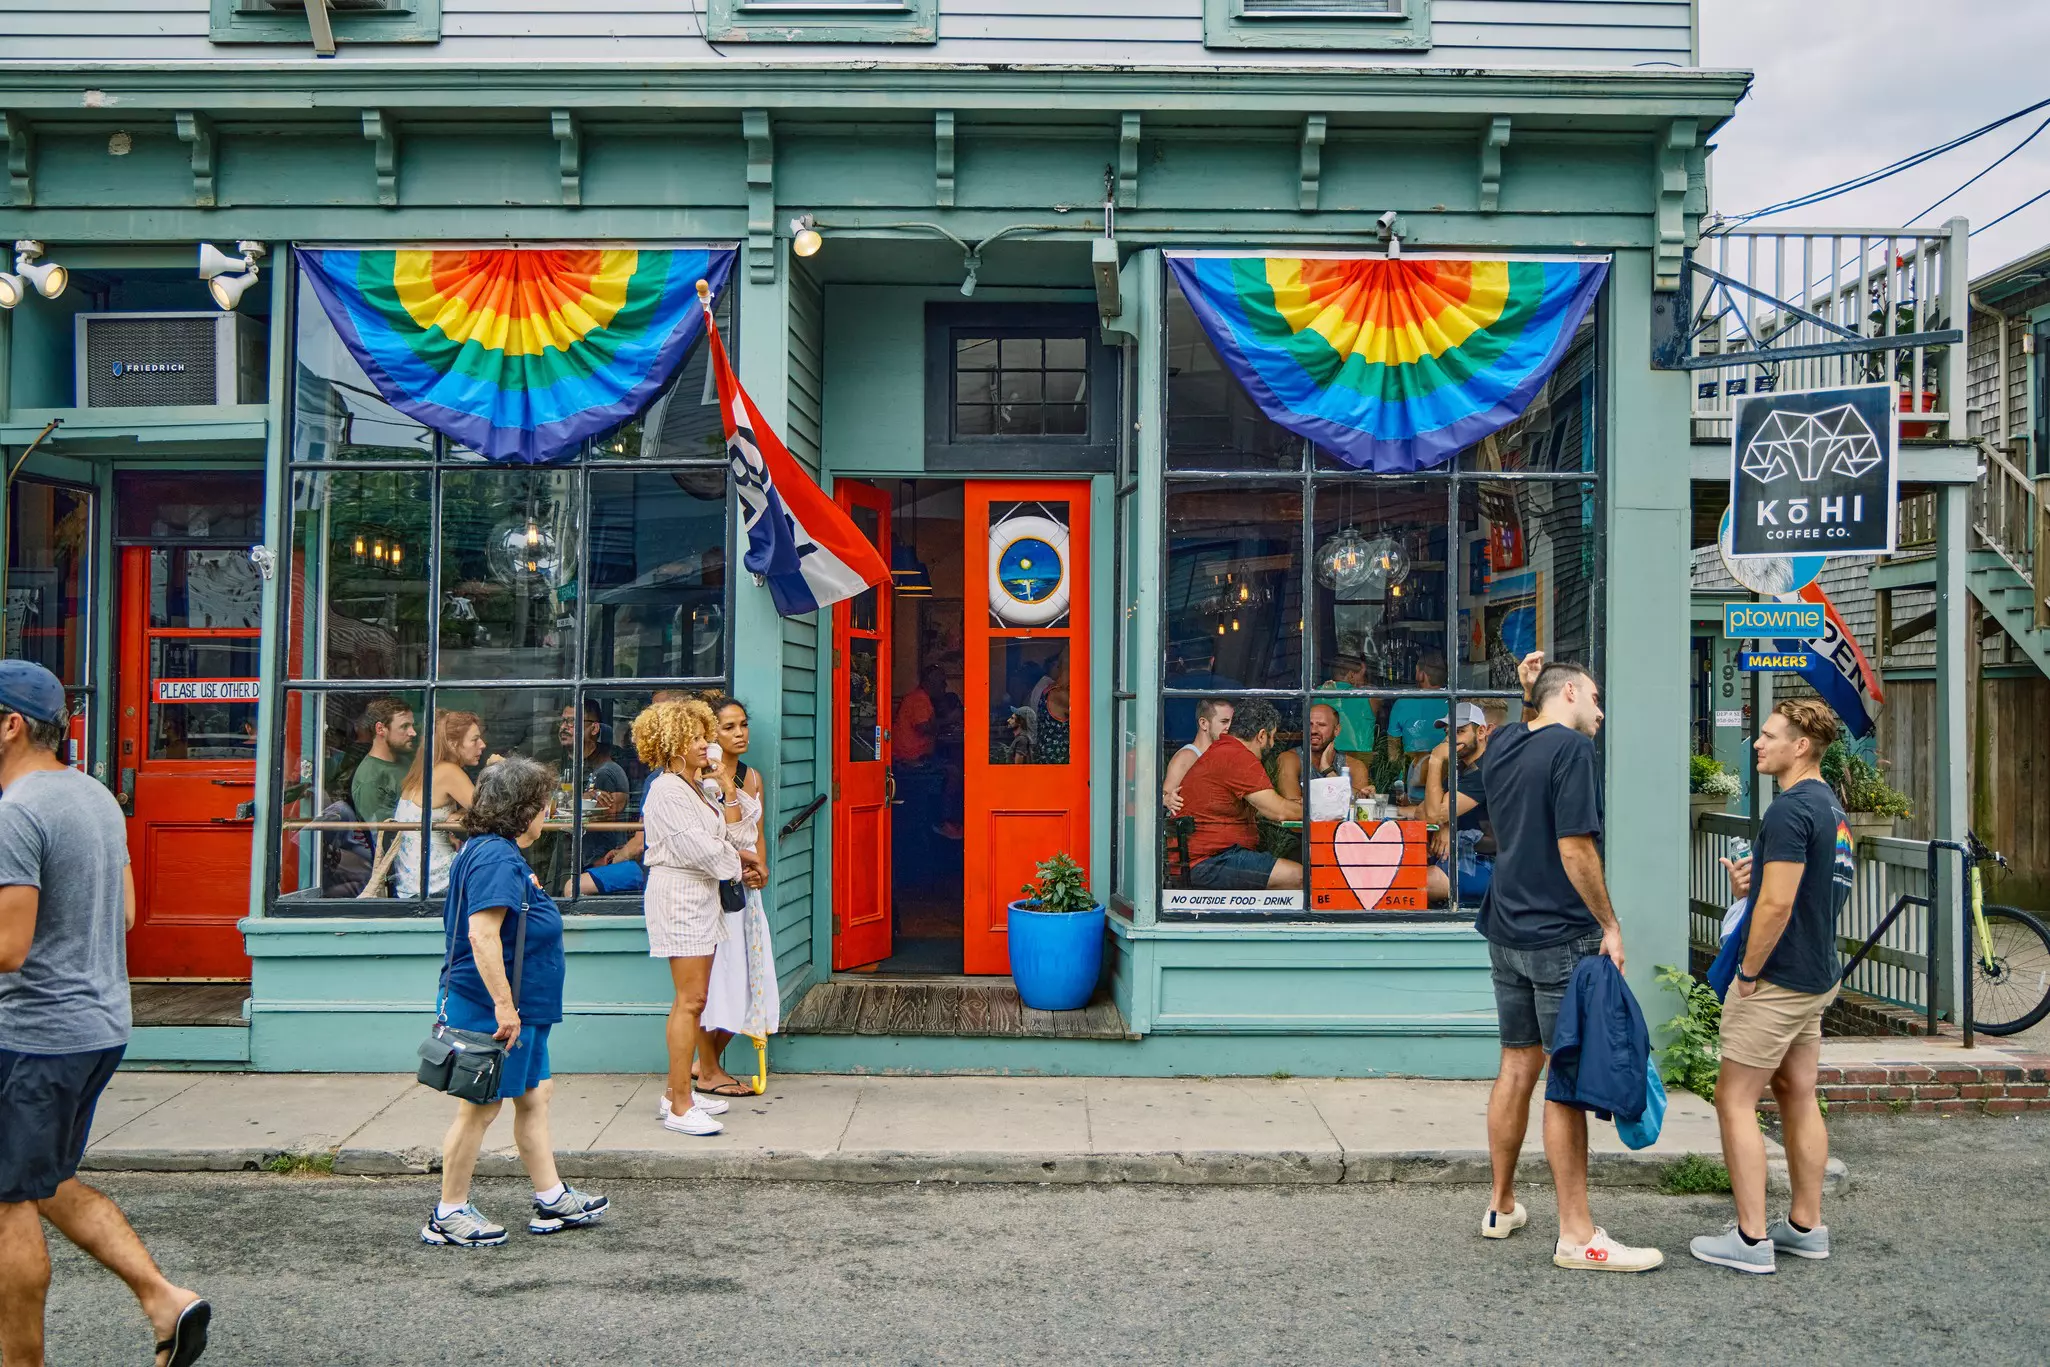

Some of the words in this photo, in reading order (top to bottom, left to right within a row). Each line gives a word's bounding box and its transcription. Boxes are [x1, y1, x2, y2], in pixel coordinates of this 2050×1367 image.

[126, 364, 185, 372] FRIEDRICH
[1766, 528, 1820, 540] COFFEE
[1826, 527, 1851, 538] CO.
[1730, 608, 1820, 633] ptownie
[1749, 655, 1808, 668] MAKERS
[160, 683, 197, 699] PLEASE
[201, 682, 218, 698] USE
[220, 682, 250, 698] OTHER
[1171, 895, 1188, 904] NO
[1190, 896, 1227, 905] OUTSIDE
[1230, 896, 1256, 906] FOOD
[1263, 896, 1294, 906] DRINK
[1317, 894, 1331, 904] BE
[1385, 896, 1415, 906] SAFE
